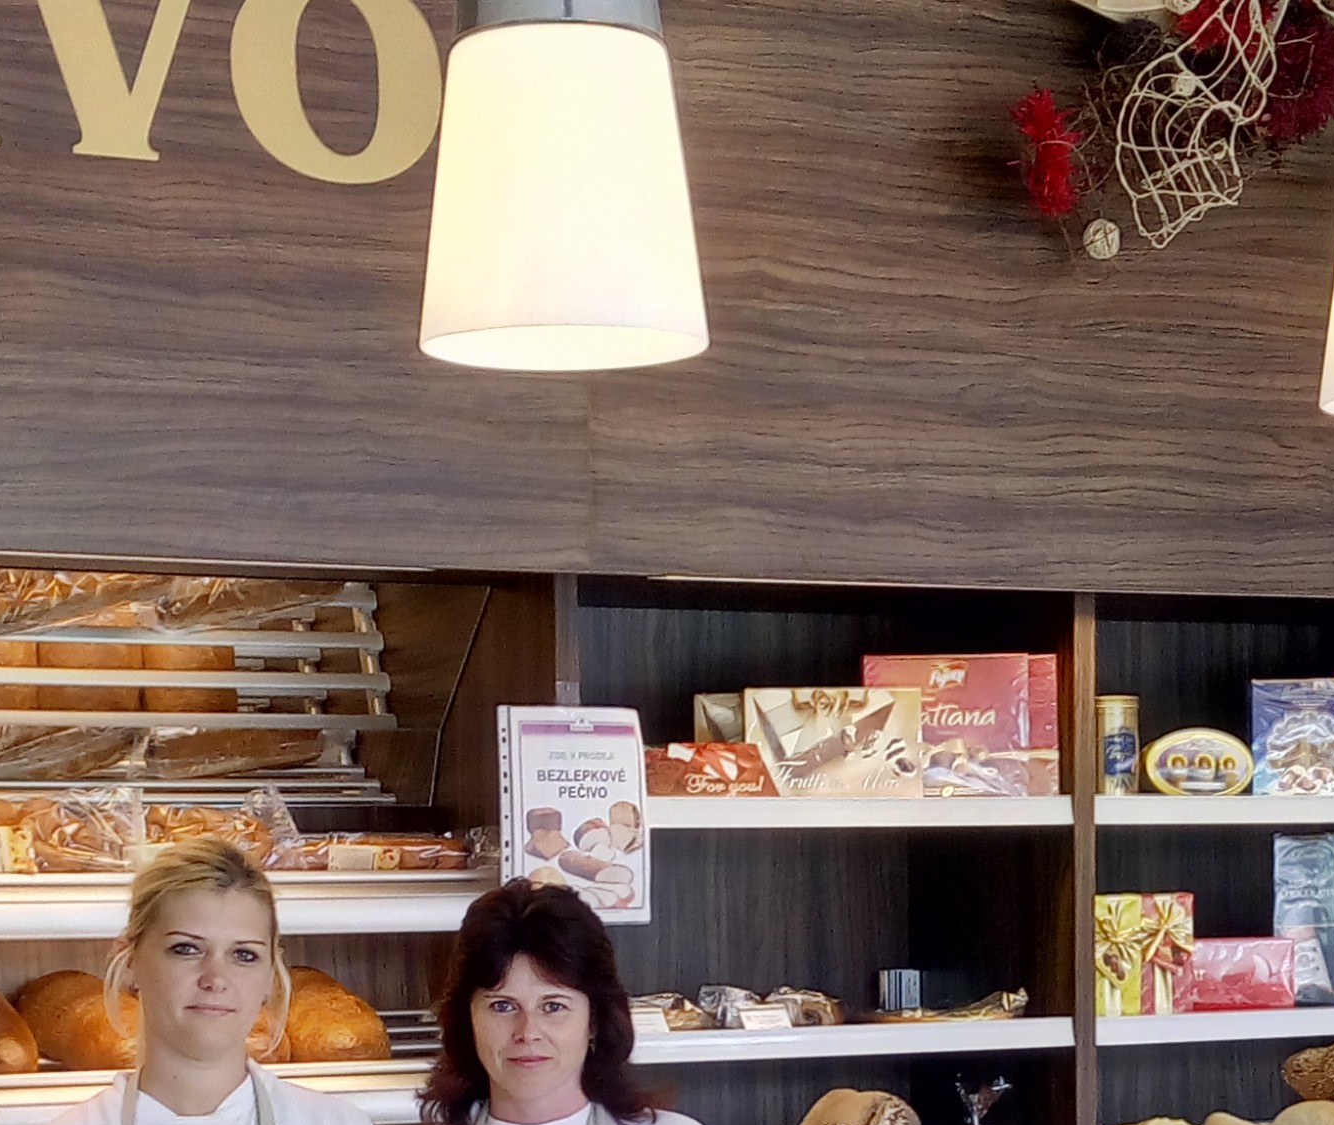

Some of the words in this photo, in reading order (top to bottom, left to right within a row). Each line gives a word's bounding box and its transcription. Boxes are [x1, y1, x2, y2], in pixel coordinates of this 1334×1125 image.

[536, 767, 628, 783] BEZLEPKOVÉ
[558, 783, 609, 799] PEČIVO
[685, 773, 726, 794] For
[728, 775, 765, 797] you!
